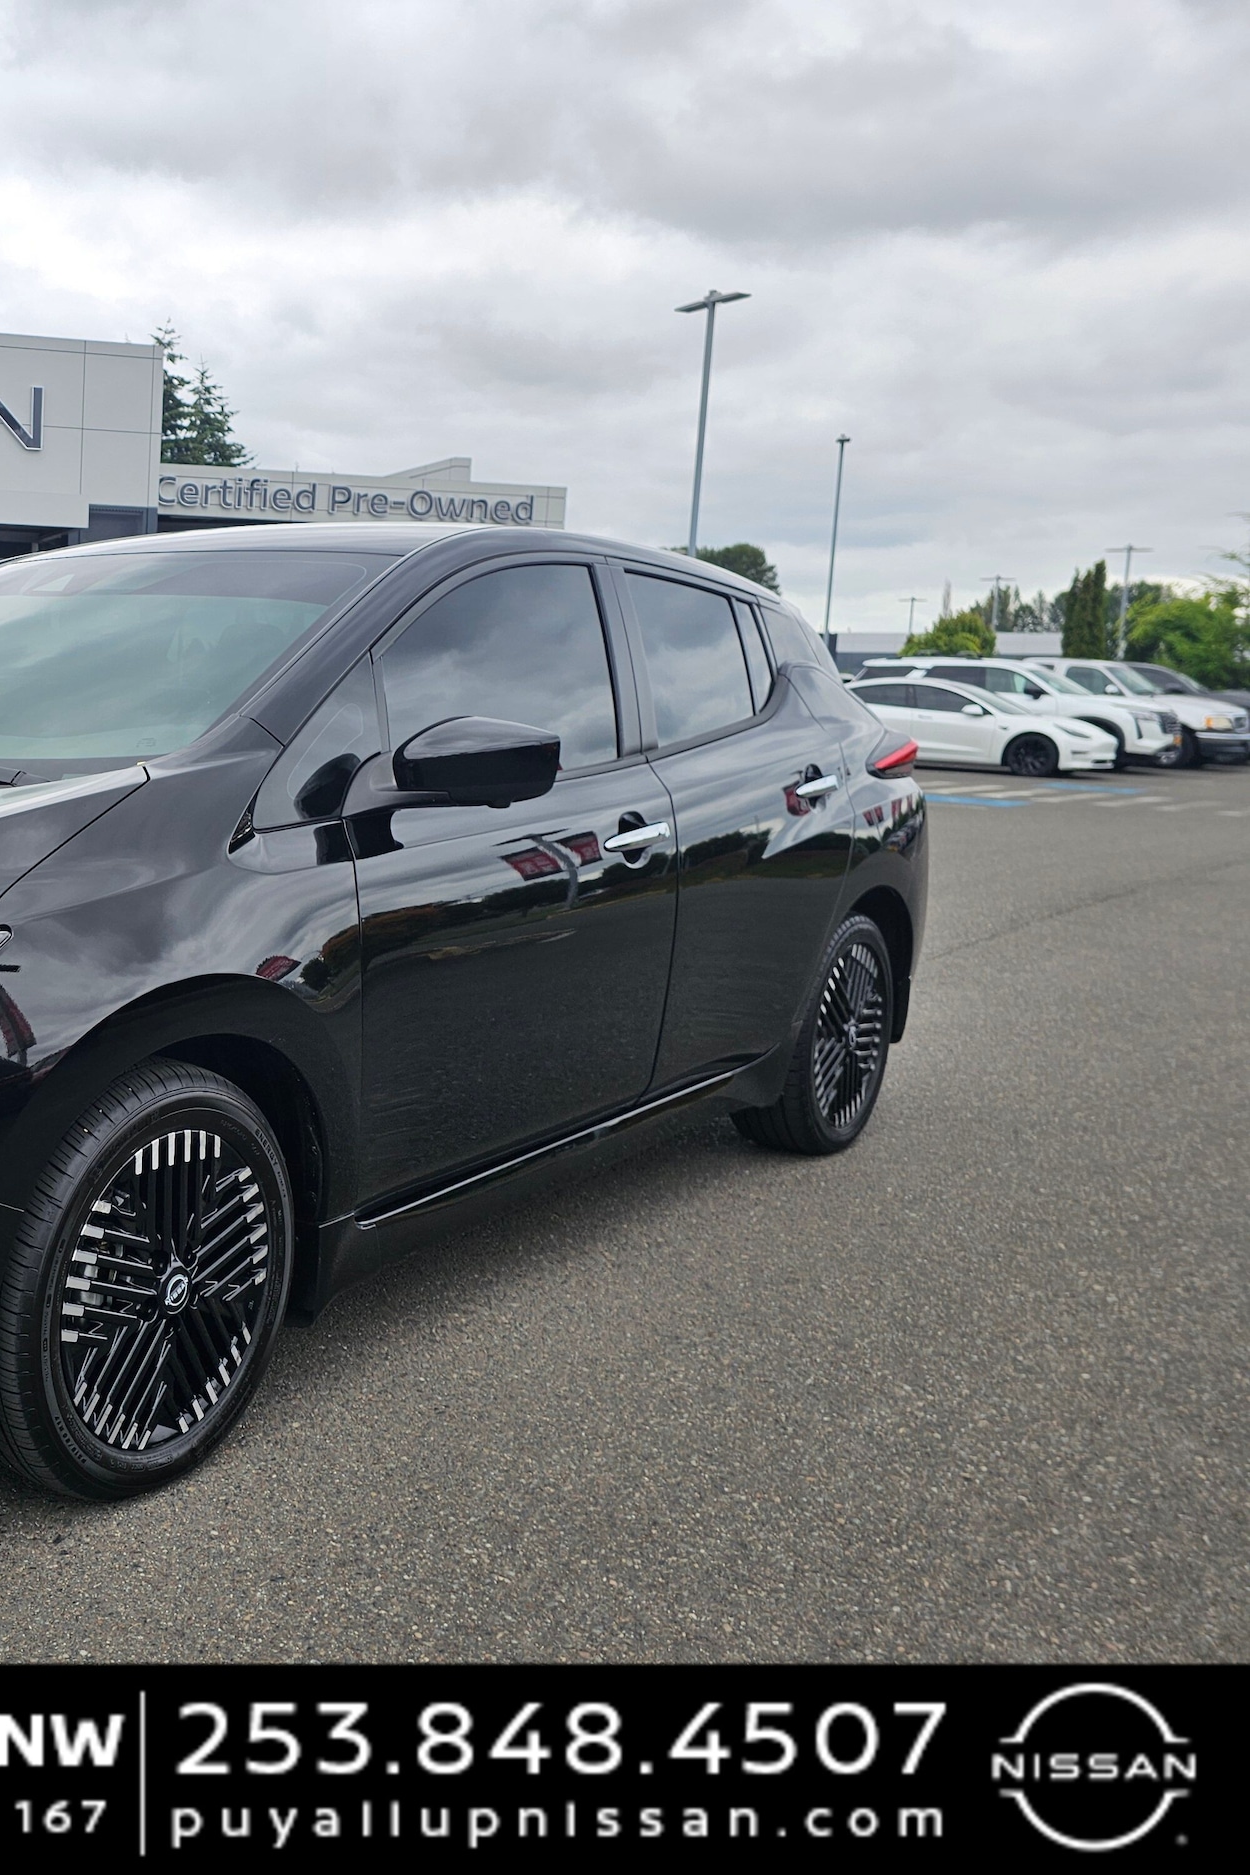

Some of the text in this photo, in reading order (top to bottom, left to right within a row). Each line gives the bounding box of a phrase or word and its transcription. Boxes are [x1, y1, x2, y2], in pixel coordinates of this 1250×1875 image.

[158, 474, 536, 525] Certified Pre-Owned
[255, 1128, 278, 1166] ENERGY
